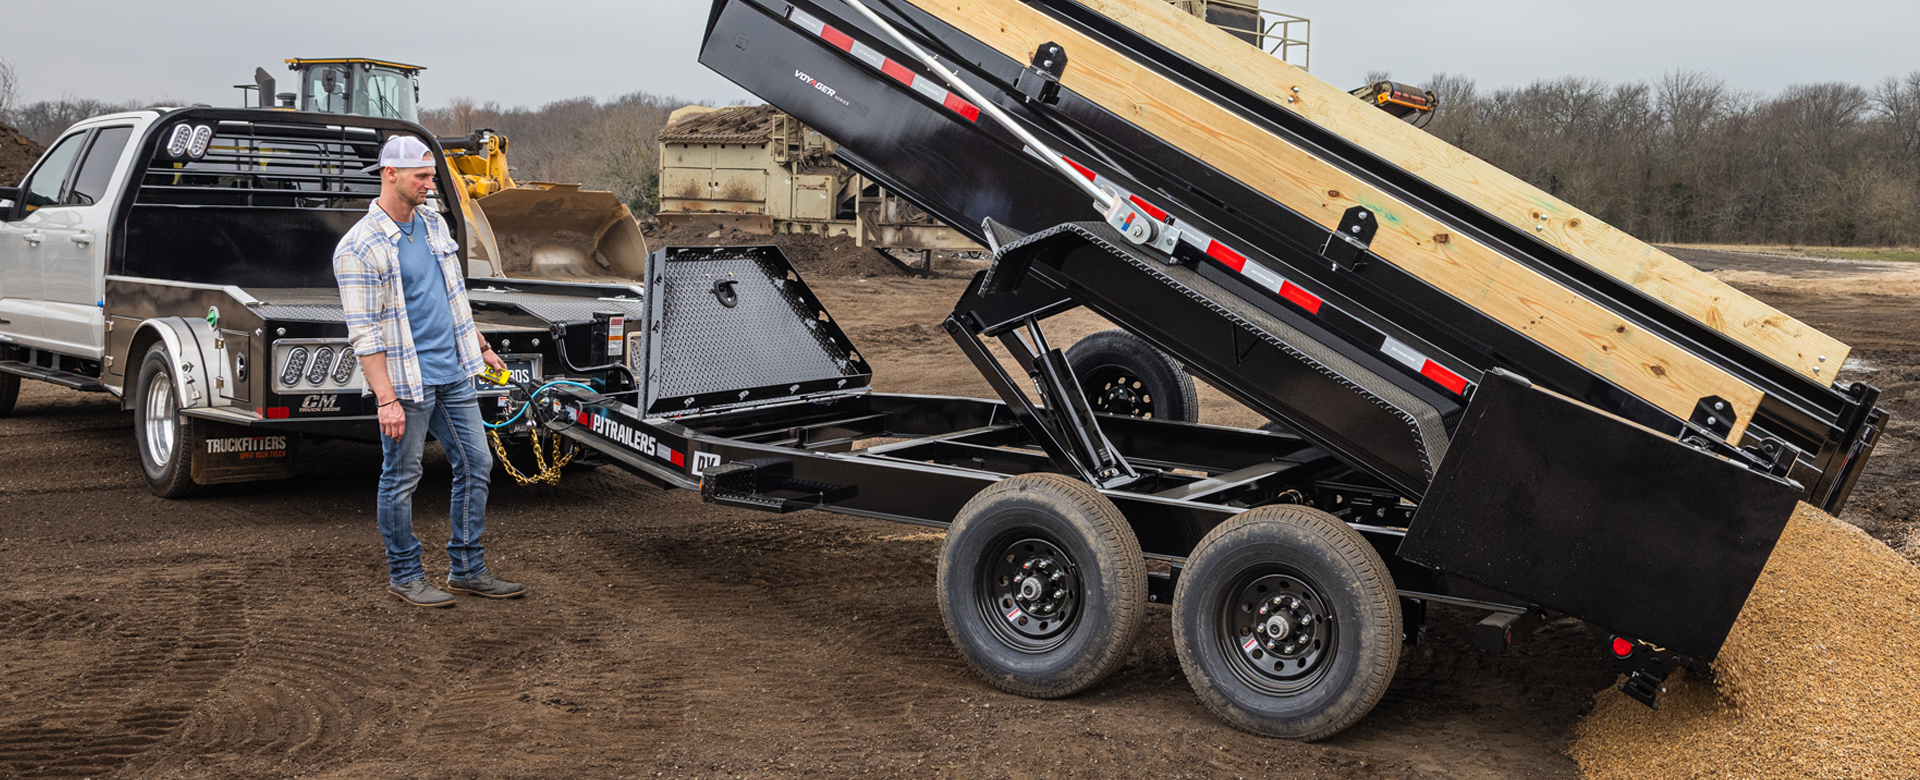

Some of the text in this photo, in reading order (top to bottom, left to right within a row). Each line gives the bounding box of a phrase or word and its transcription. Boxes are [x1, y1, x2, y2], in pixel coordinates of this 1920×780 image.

[794, 69, 836, 98] VOYAGER
[301, 394, 338, 408] CM
[206, 436, 286, 454] TRUCKFITTERS
[239, 450, 287, 460] UPFIT YOUR TRUCK
